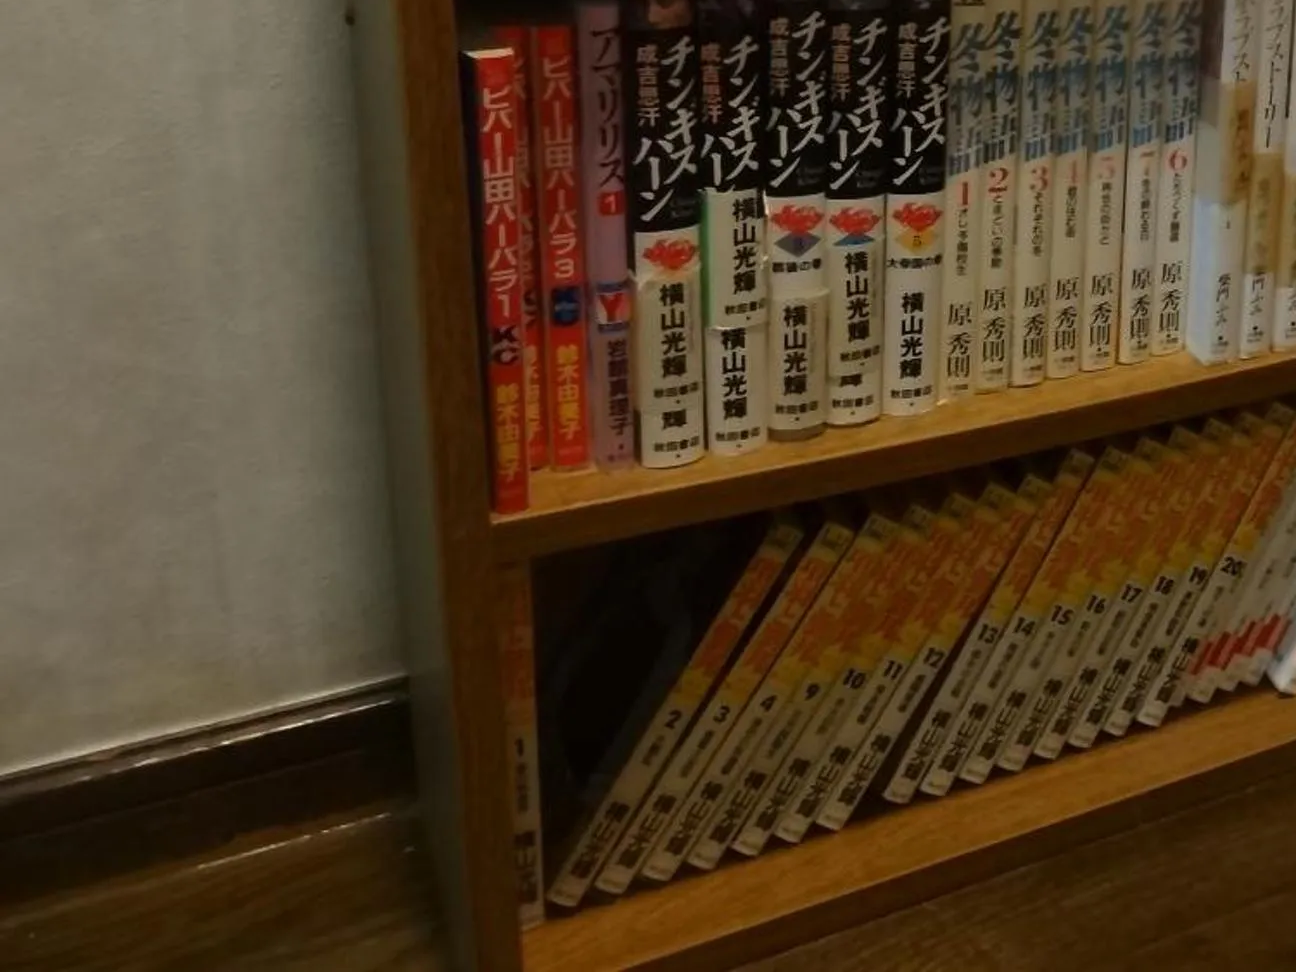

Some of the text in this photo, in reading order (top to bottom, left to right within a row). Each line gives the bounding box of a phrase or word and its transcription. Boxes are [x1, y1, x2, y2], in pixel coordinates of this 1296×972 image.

[700, 134, 735, 187] ハー
[733, 198, 757, 294] 横山光輝
[660, 283, 687, 378] 横山光輝
[846, 251, 870, 341] 横山光輝
[982, 287, 1007, 362] 原秀則
[1022, 283, 1046, 359] 原秀則
[1054, 277, 1079, 351] 原秀則
[1089, 272, 1114, 345] 原秀則
[1130, 268, 1151, 340] 原秀則
[1158, 261, 1181, 332] 原秀則
[784, 305, 808, 396] 横山光輝
[901, 292, 925, 379] 横山光輝
[947, 303, 972, 377] 原秀則
[721, 328, 747, 420] 横山光輝
[1013, 616, 1035, 637] 14
[1051, 605, 1074, 625] 15
[1086, 594, 1106, 615] 16
[1121, 585, 1142, 603] 17
[923, 646, 945, 668] 12
[978, 623, 999, 644] 13
[883, 660, 902, 680] 11
[663, 710, 682, 729] 2
[713, 705, 731, 724] 3
